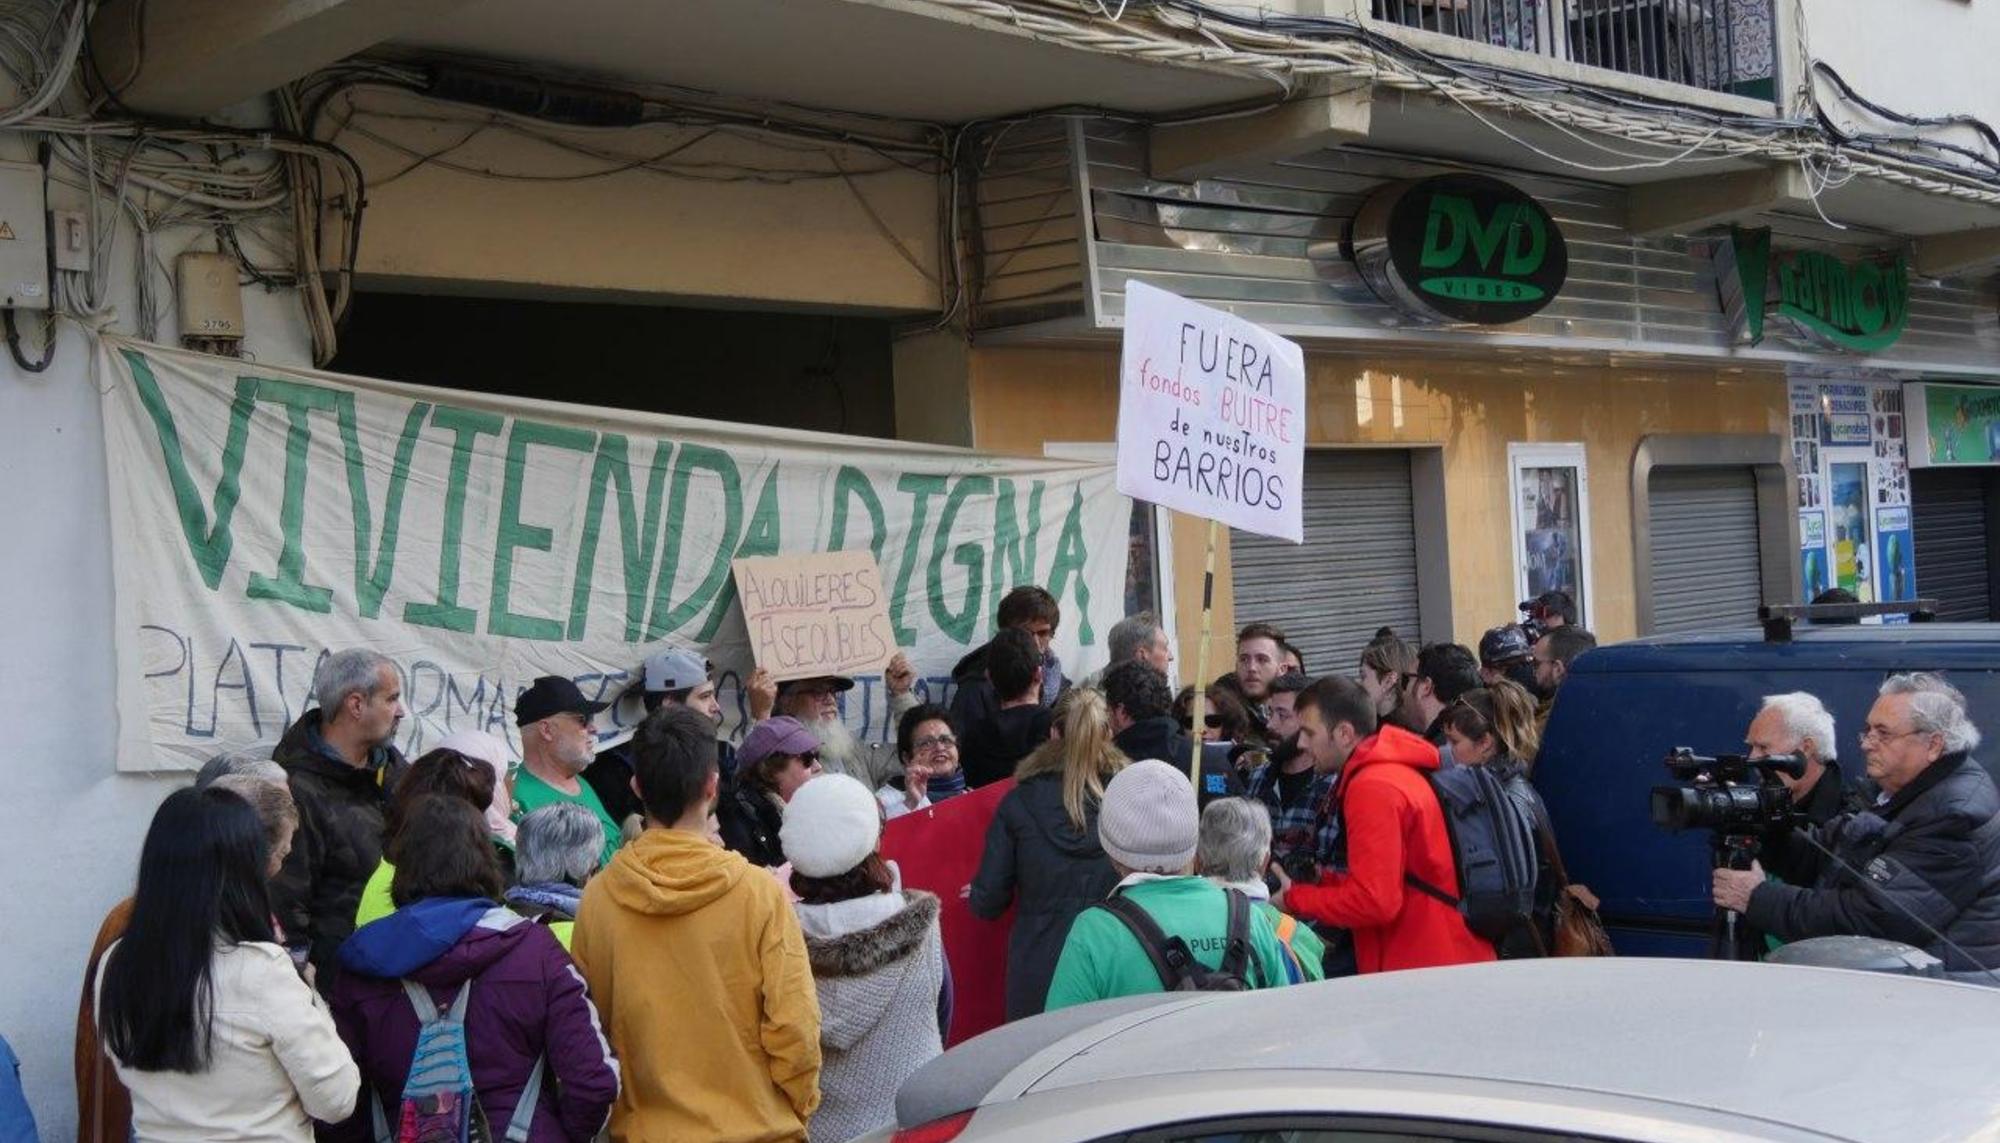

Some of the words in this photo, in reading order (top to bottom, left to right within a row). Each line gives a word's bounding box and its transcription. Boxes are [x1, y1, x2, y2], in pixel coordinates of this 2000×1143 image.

[1420, 194, 1547, 275] DVD
[1443, 282, 1522, 298] VIDEO
[1181, 322, 1273, 397] FUERA
[1140, 357, 1201, 407] fondos
[1220, 386, 1293, 444] BUITRE
[1170, 407, 1190, 436] de
[117, 347, 780, 644] VIVIENDA
[828, 465, 1096, 647] DIGNA
[1154, 440, 1284, 511] BARRIOS
[744, 565, 877, 614] ALQUILERES
[1190, 937, 1228, 952] PUED
